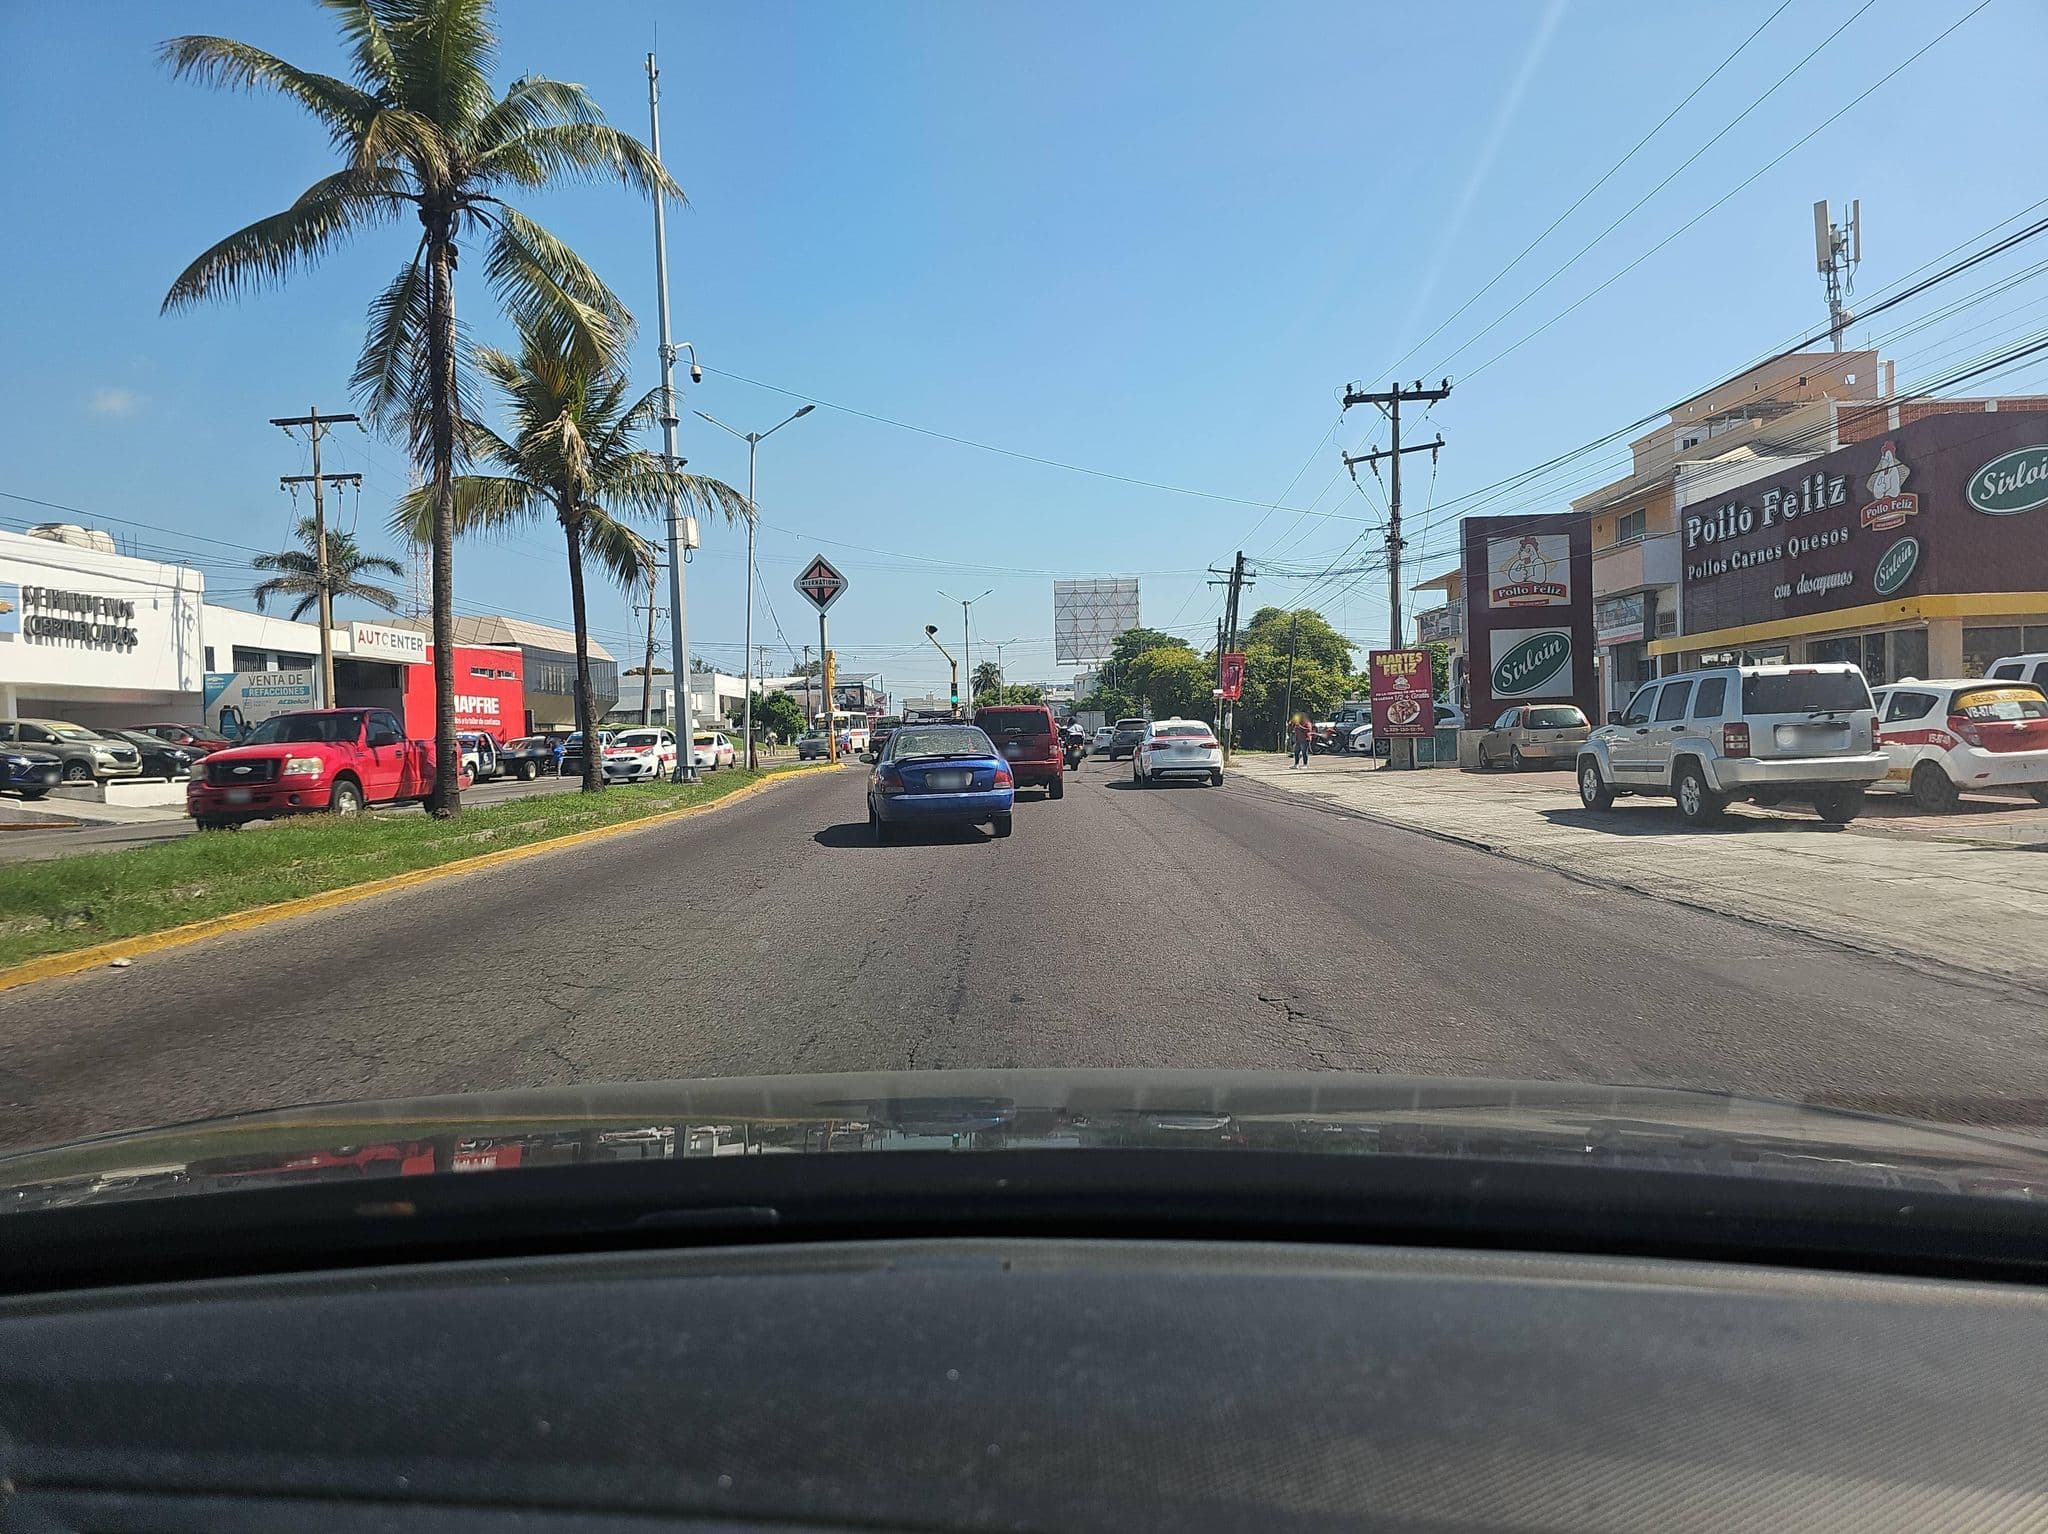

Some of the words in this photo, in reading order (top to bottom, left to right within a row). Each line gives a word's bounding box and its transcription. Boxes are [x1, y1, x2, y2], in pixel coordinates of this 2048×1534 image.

[1686, 502, 1753, 550] Pollo
[1761, 472, 1847, 528] Feliz
[1866, 503, 1888, 519] Pollo
[1891, 499, 1913, 512] Feliz
[1688, 558, 1727, 580] Pollos
[1732, 546, 1782, 569] Carnes
[1788, 527, 1849, 559] Quesos
[1879, 544, 1912, 587] Sirloin
[1498, 585, 1529, 598] Pollo
[1533, 584, 1561, 596] Feliz
[1774, 584, 1792, 600] con
[1376, 652, 1423, 665] MARTES
[1501, 639, 1563, 688] Sirloin
[1383, 662, 1417, 675] FELIZ
[248, 674, 285, 686] VENTA
[288, 673, 303, 685] DE
[249, 687, 305, 697] REFACCIONES
